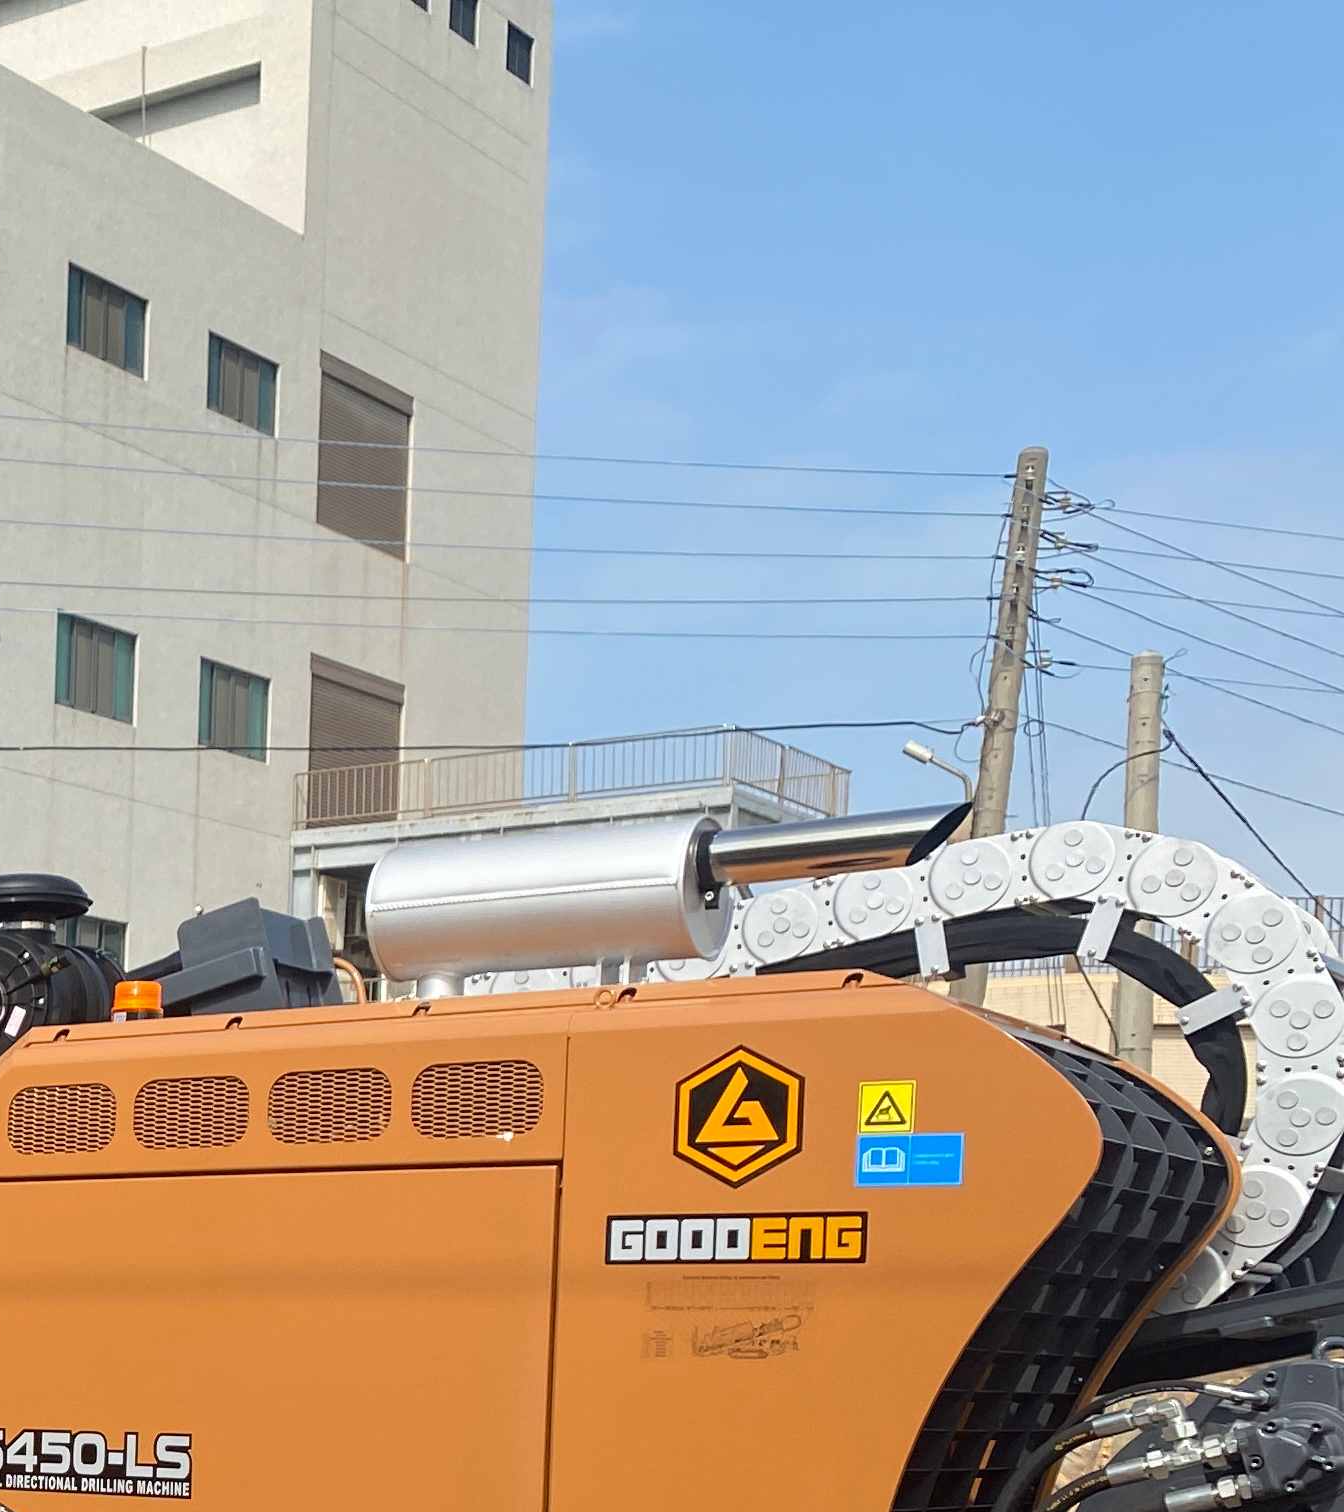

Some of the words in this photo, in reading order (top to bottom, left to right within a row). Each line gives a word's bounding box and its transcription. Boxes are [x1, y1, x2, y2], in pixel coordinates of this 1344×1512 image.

[610, 1215, 863, 1262] GOODENG
[5, 1474, 78, 1492] DIRECTIONAL
[80, 1477, 134, 1495] DRILLING
[136, 1480, 190, 1497] MACHINE
